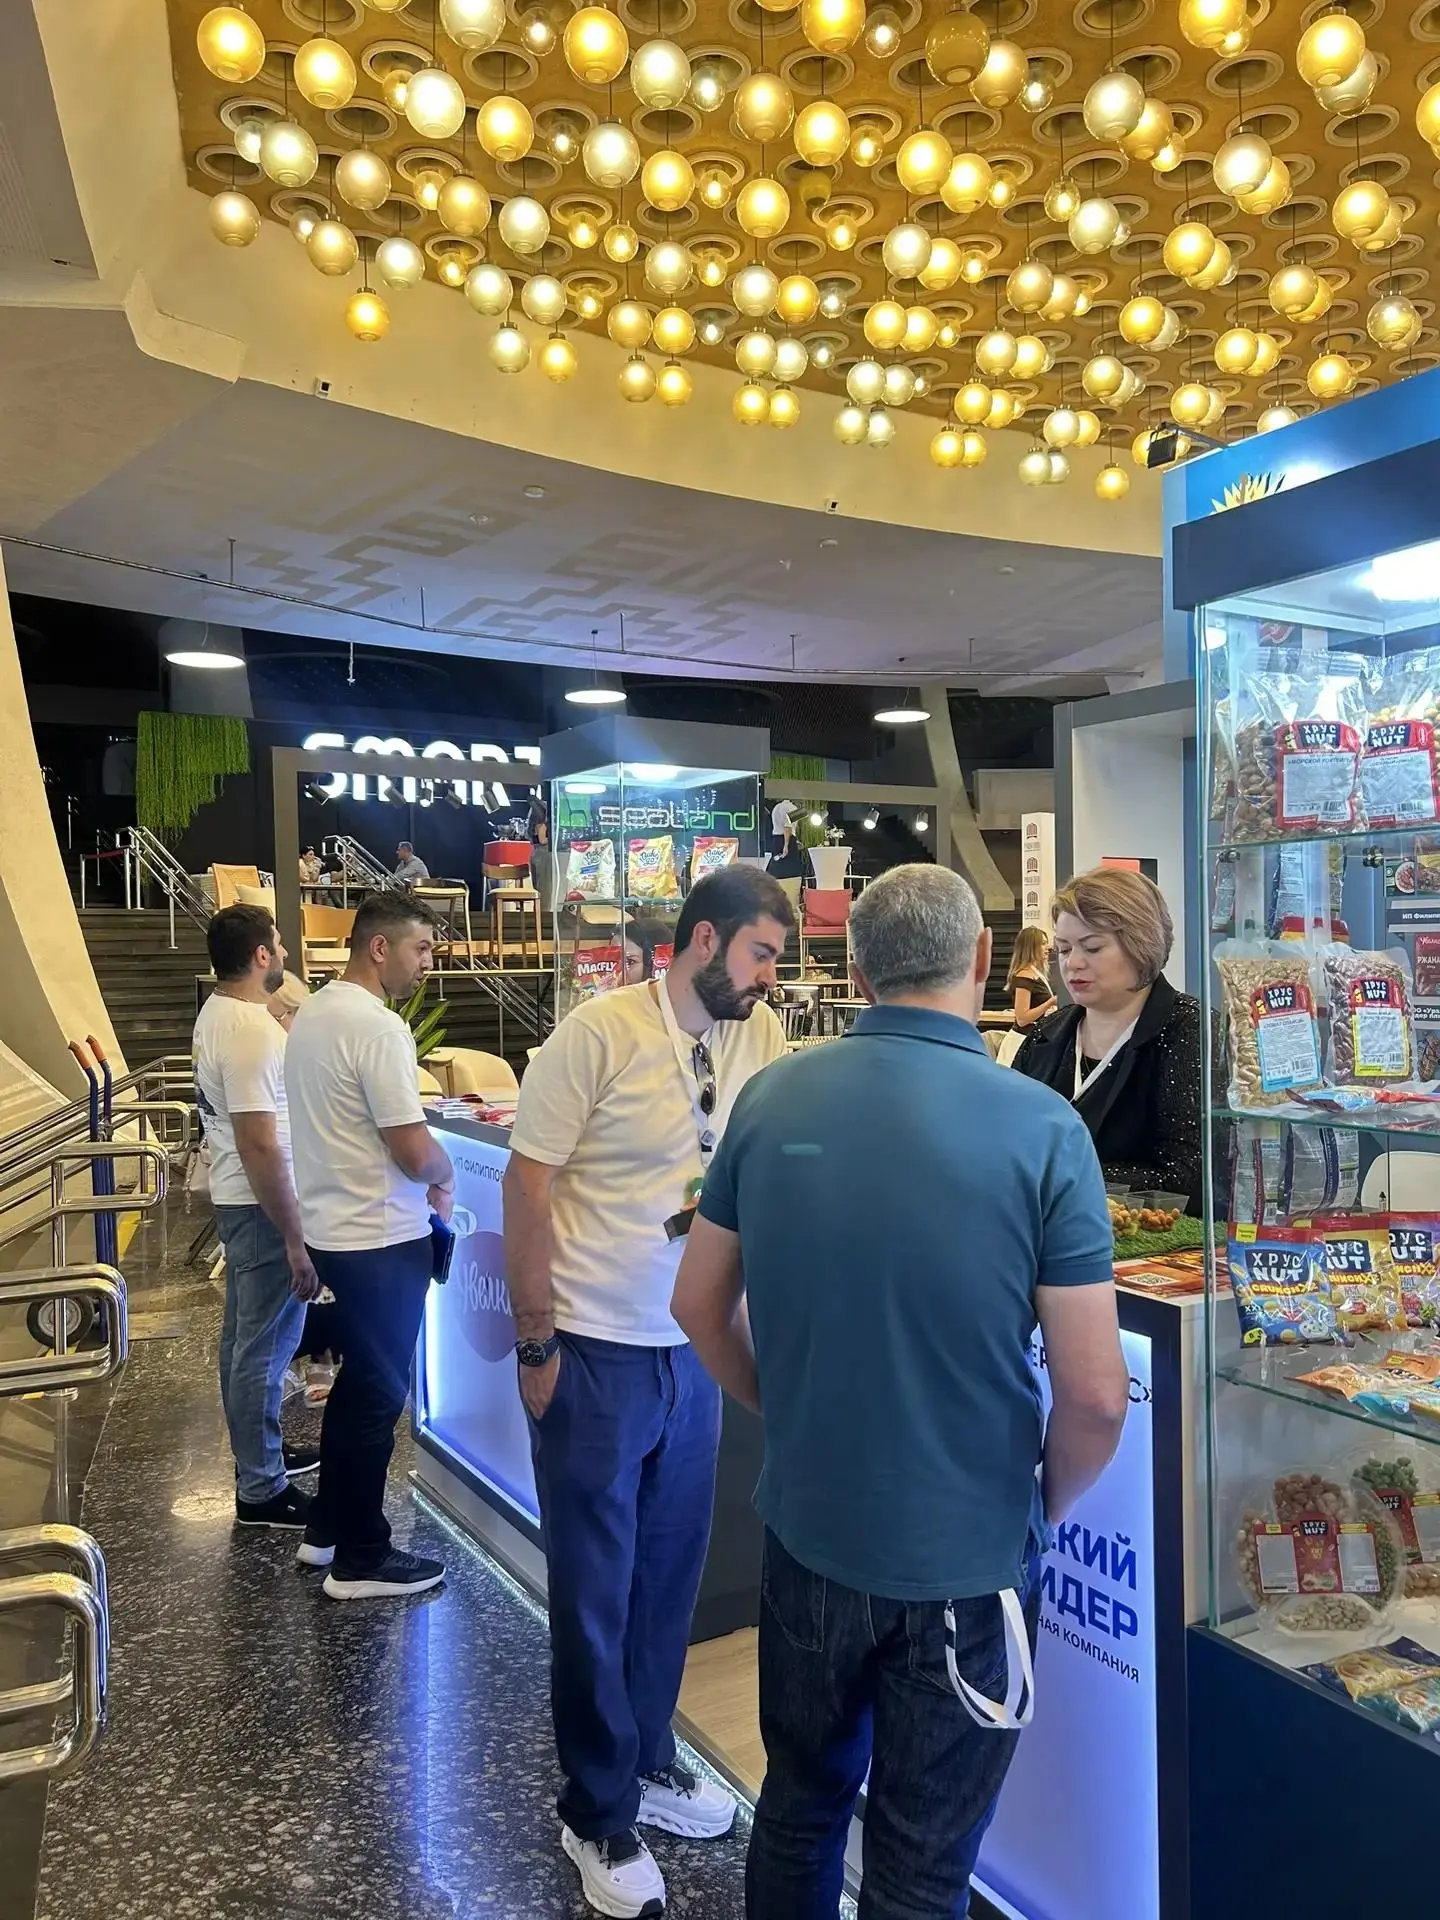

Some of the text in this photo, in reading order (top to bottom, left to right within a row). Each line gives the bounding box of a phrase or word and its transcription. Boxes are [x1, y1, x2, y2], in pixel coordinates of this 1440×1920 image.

[1305, 733, 1337, 744] NUT
[1371, 725, 1405, 738] ХРУС
[1372, 735, 1404, 748] NUT
[1389, 1232, 1426, 1247] РУС
[1326, 1241, 1364, 1256] РУС
[1392, 1246, 1427, 1260] UT
[1252, 1252, 1302, 1269] ХРУС
[1252, 1267, 1303, 1281] NUT
[1051, 1521, 1137, 1591] КИЙ
[1041, 1564, 1138, 1640] ИДЕР
[1037, 1615, 1139, 1683] НАЯ КОМПАНИЯ
